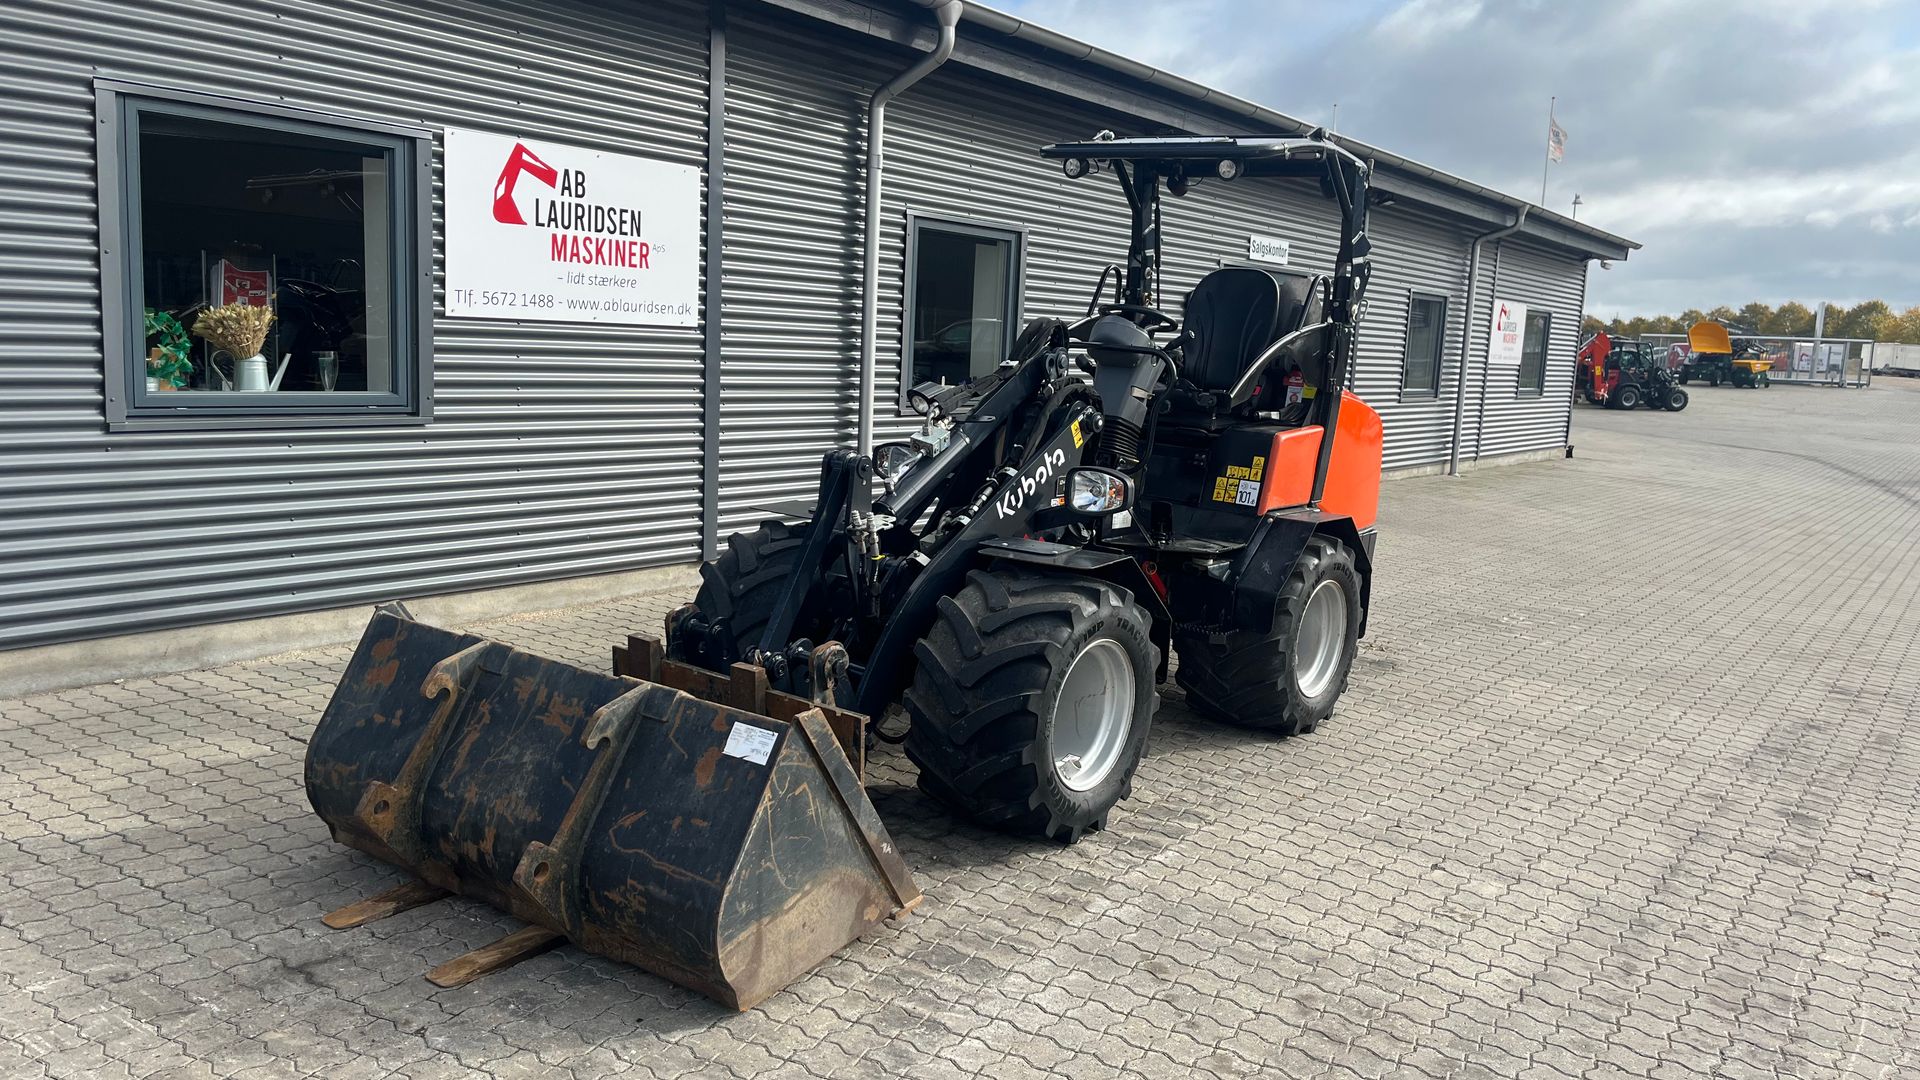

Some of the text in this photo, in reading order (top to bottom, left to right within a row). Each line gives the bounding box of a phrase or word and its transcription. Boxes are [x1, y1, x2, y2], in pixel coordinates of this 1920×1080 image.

[560, 168, 587, 199] AB
[534, 198, 642, 238] LAURIDSEN
[551, 233, 666, 270] MASKINER ApS
[1251, 239, 1287, 257] Salgskontor
[566, 271, 585, 285] lidt
[587, 273, 638, 289] stærkere
[454, 289, 478, 308] Tlf.
[482, 290, 517, 308] 5672
[521, 292, 555, 309] 1488
[566, 295, 693, 317] www.ablauridsen.dk
[995, 447, 1066, 520] Kubota
[1238, 490, 1252, 505] 101
